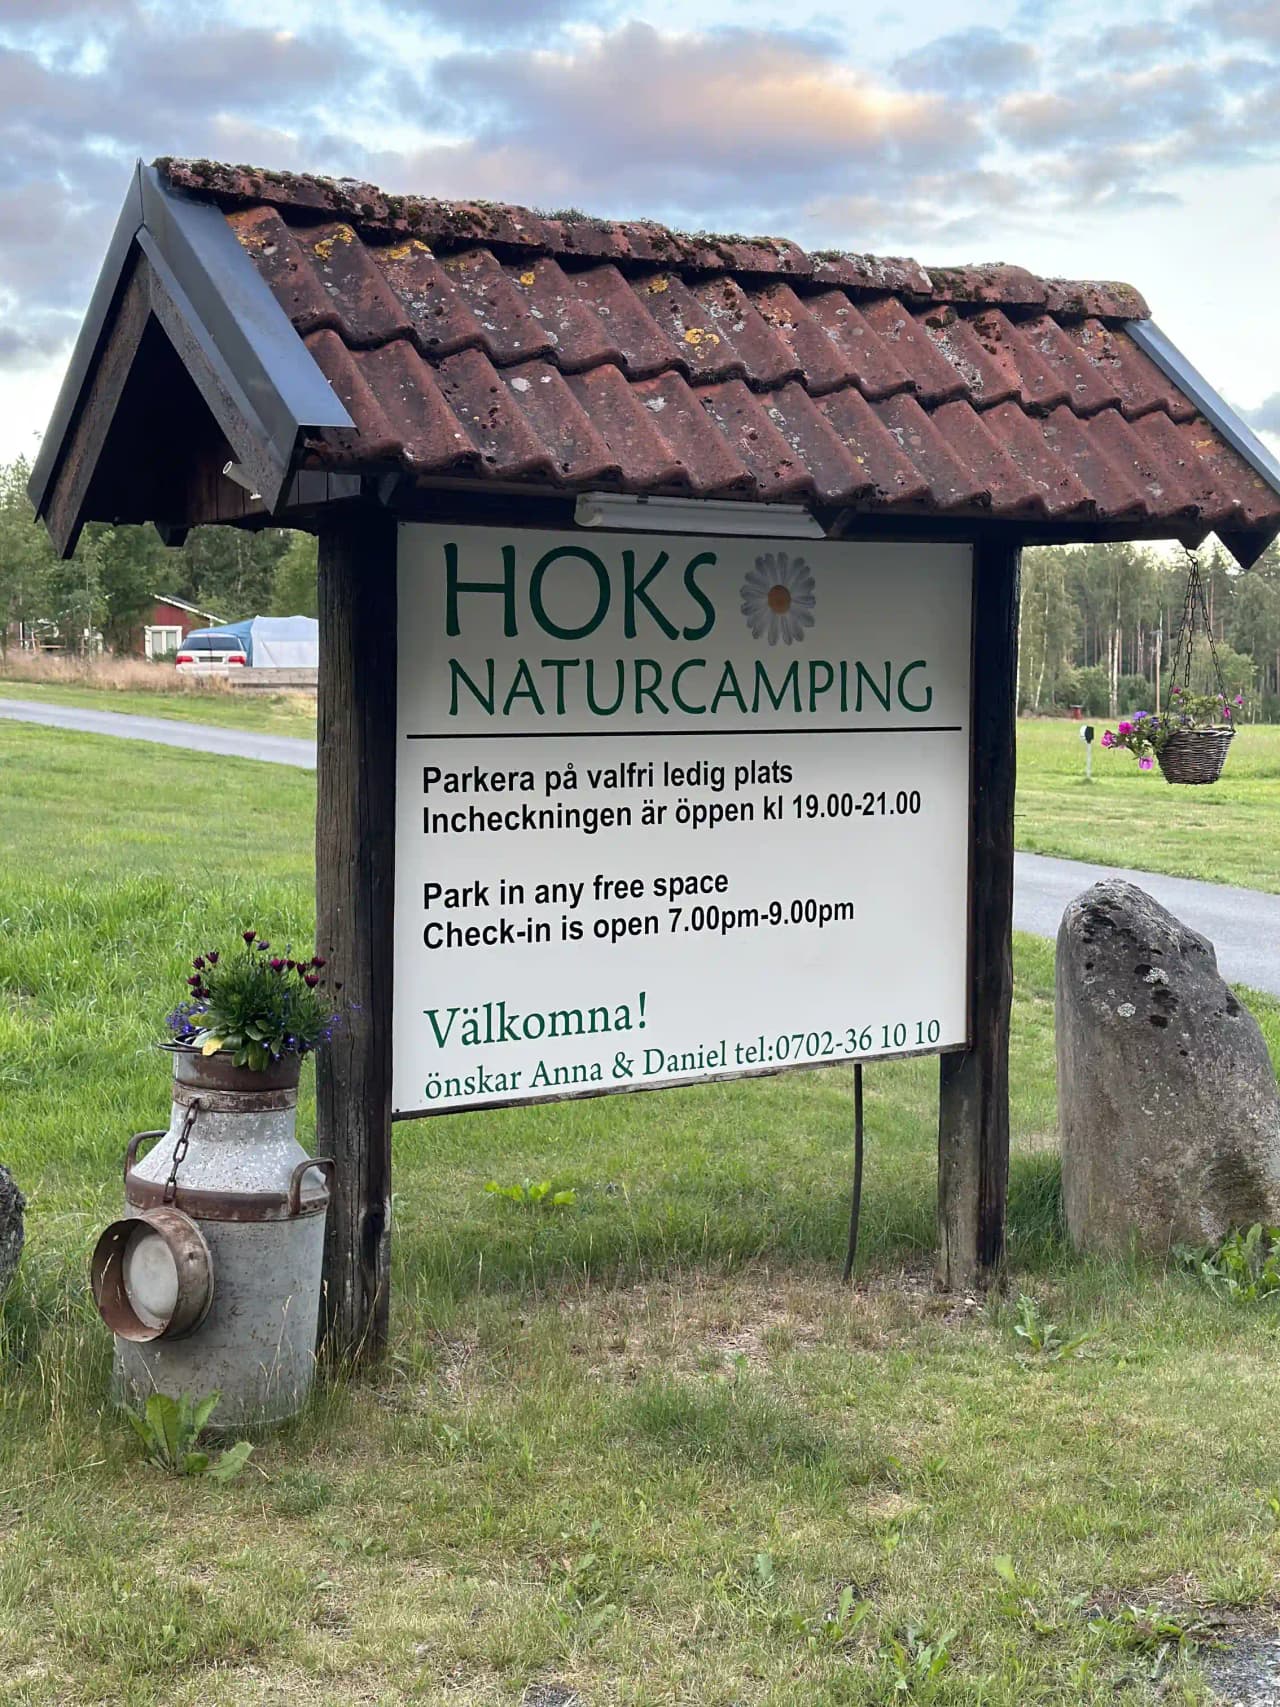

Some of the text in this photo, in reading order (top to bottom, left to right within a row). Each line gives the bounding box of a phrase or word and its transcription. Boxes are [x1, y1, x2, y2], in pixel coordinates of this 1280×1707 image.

[444, 543, 717, 641] HOKS
[448, 658, 932, 716] NATURCAMPING
[424, 760, 792, 797] Parkera på valfri ledig plats
[424, 791, 920, 834] Incheckningen är öppen kl 19.00-21.00
[424, 874, 728, 909] Park in any free space
[424, 899, 853, 949] Check-in is open 7.00pm-9.00pm
[423, 992, 645, 1048] Välkomna!
[426, 1020, 940, 1099] önskar Anna & Daniel tel:0702-36 10 10
